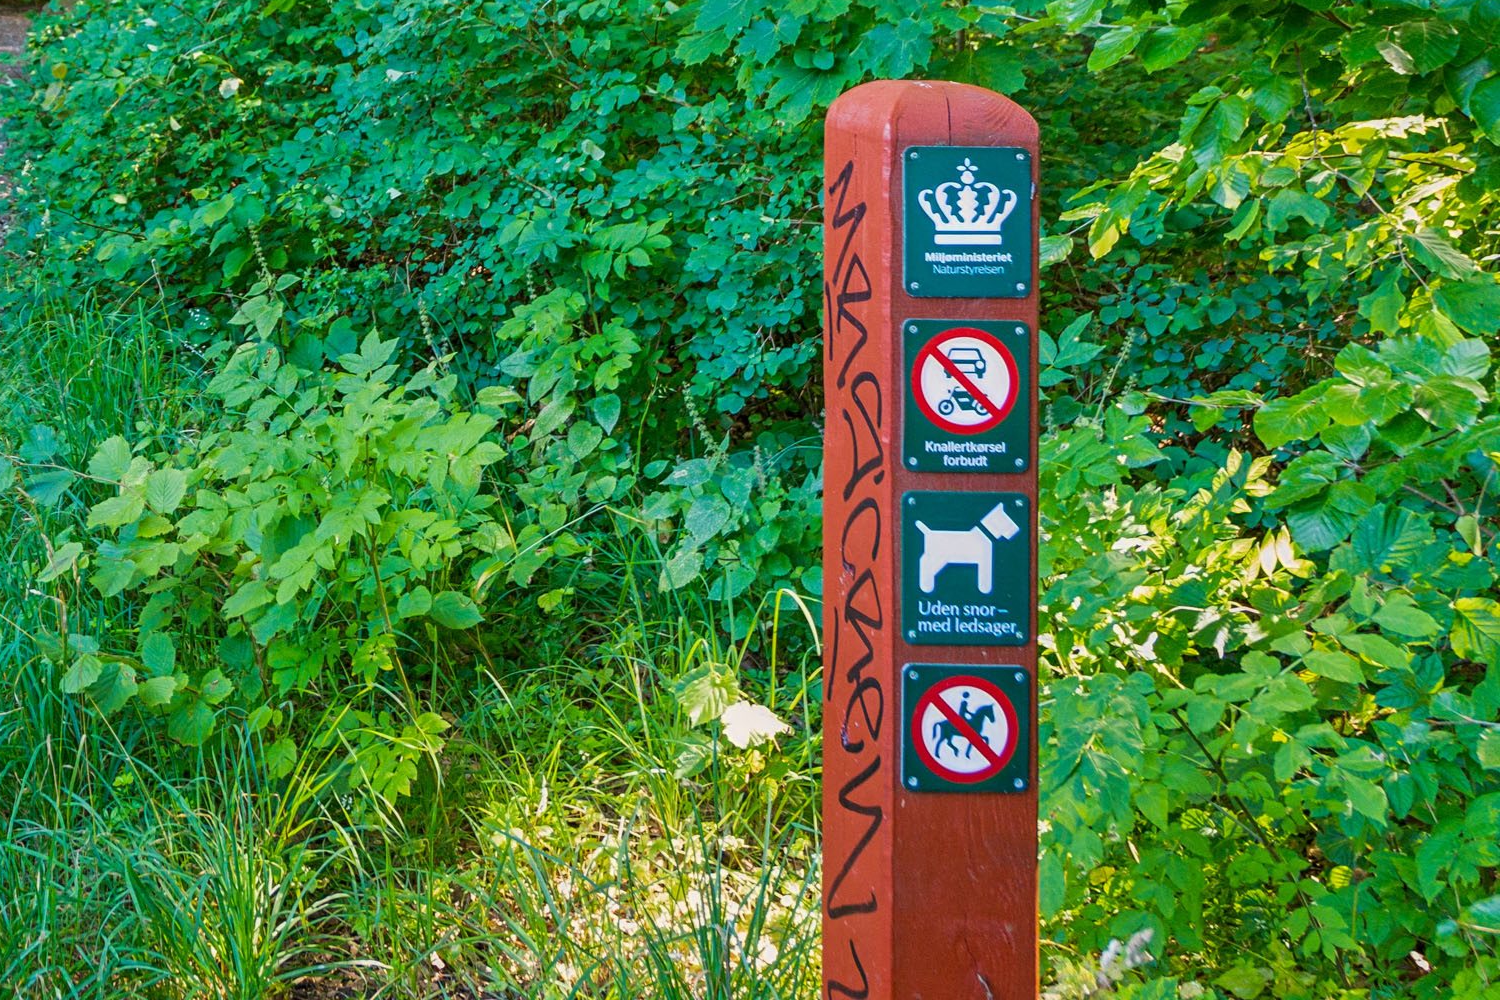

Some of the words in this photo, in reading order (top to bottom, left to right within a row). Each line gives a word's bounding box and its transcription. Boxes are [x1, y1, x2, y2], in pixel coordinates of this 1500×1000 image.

[925, 252, 1012, 263] Miljøministeriet
[933, 265, 1004, 275] Naturstyrelsen
[925, 441, 1005, 453] Knallertkørsel
[943, 455, 988, 467] forbudt
[918, 600, 960, 616] Uden
[918, 617, 950, 632] med
[955, 618, 1017, 636] ledsager
